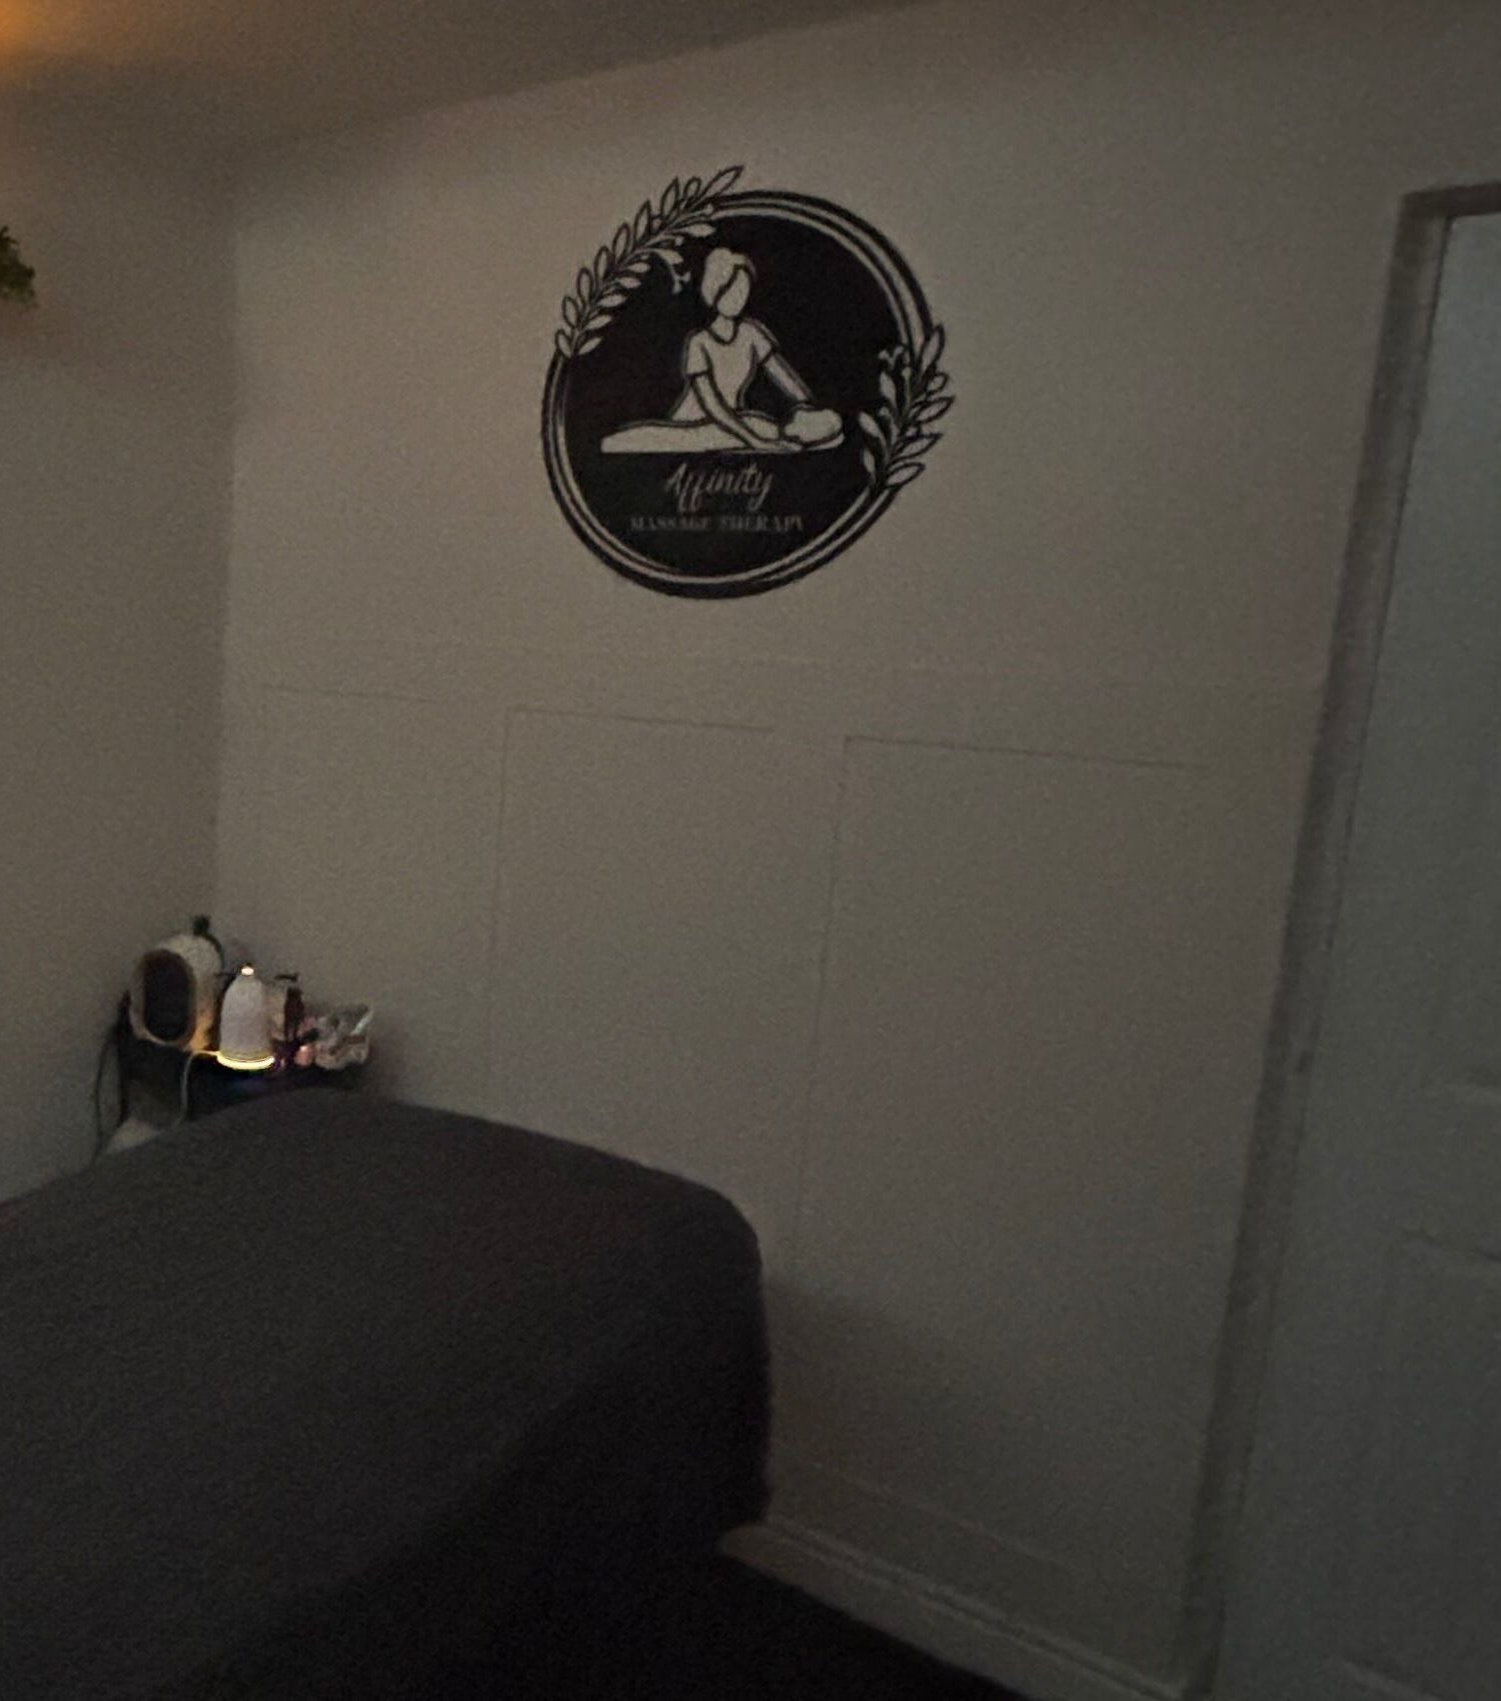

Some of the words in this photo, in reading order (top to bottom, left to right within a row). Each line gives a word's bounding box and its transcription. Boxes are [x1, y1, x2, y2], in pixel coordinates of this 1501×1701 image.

[664, 462, 775, 513] Affinity
[630, 515, 708, 531] MASSAGE
[720, 515, 804, 531] THERAPY
